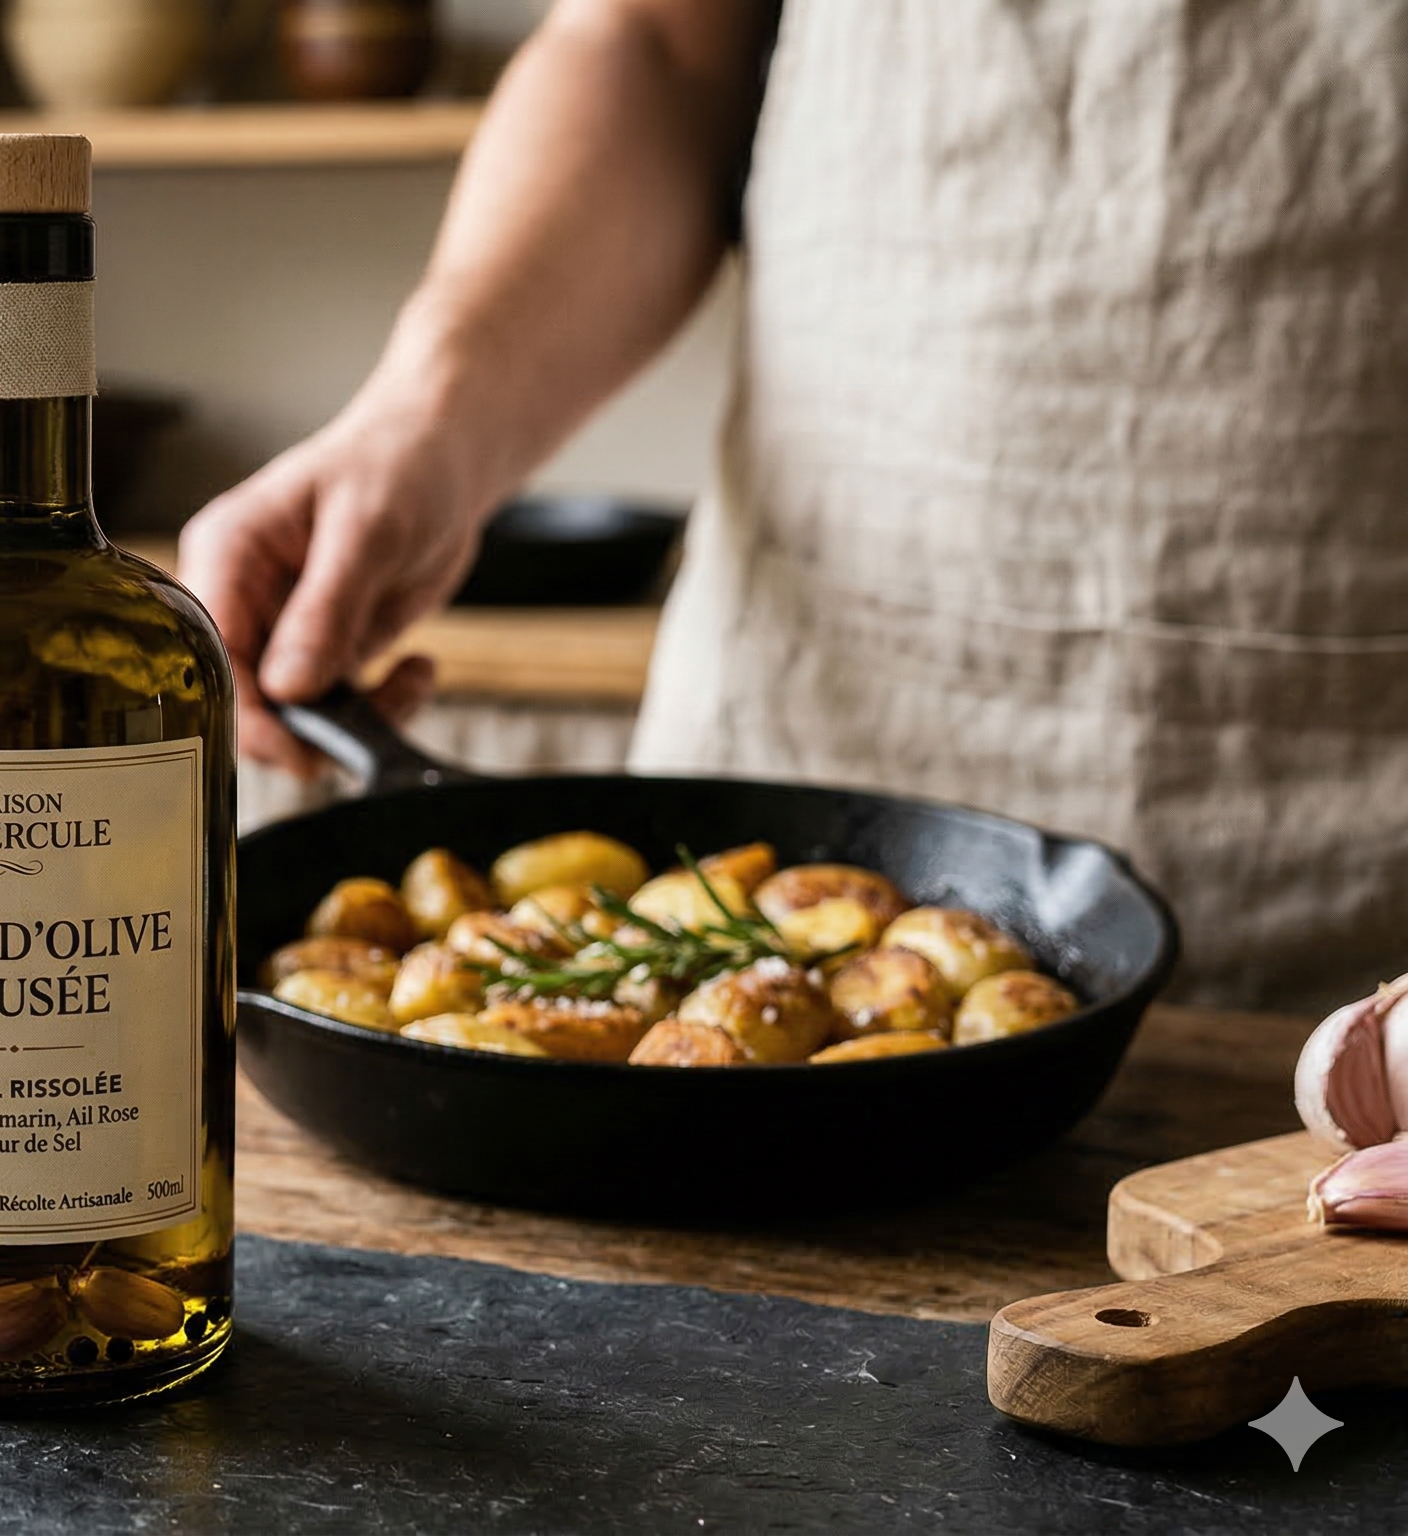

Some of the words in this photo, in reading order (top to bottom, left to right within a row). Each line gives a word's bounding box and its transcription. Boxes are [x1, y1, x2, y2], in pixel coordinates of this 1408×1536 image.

[0, 910, 173, 961] D’OLIVE
[10, 1071, 122, 1098] RISSOLÉE
[66, 1105, 93, 1126] Ail
[98, 1105, 139, 1124] Rose
[24, 1133, 48, 1153] de
[53, 1131, 81, 1151] Sel
[0, 1194, 56, 1211] Récolte
[58, 1187, 133, 1210] Artisanale
[147, 1174, 184, 1200] 500ml
